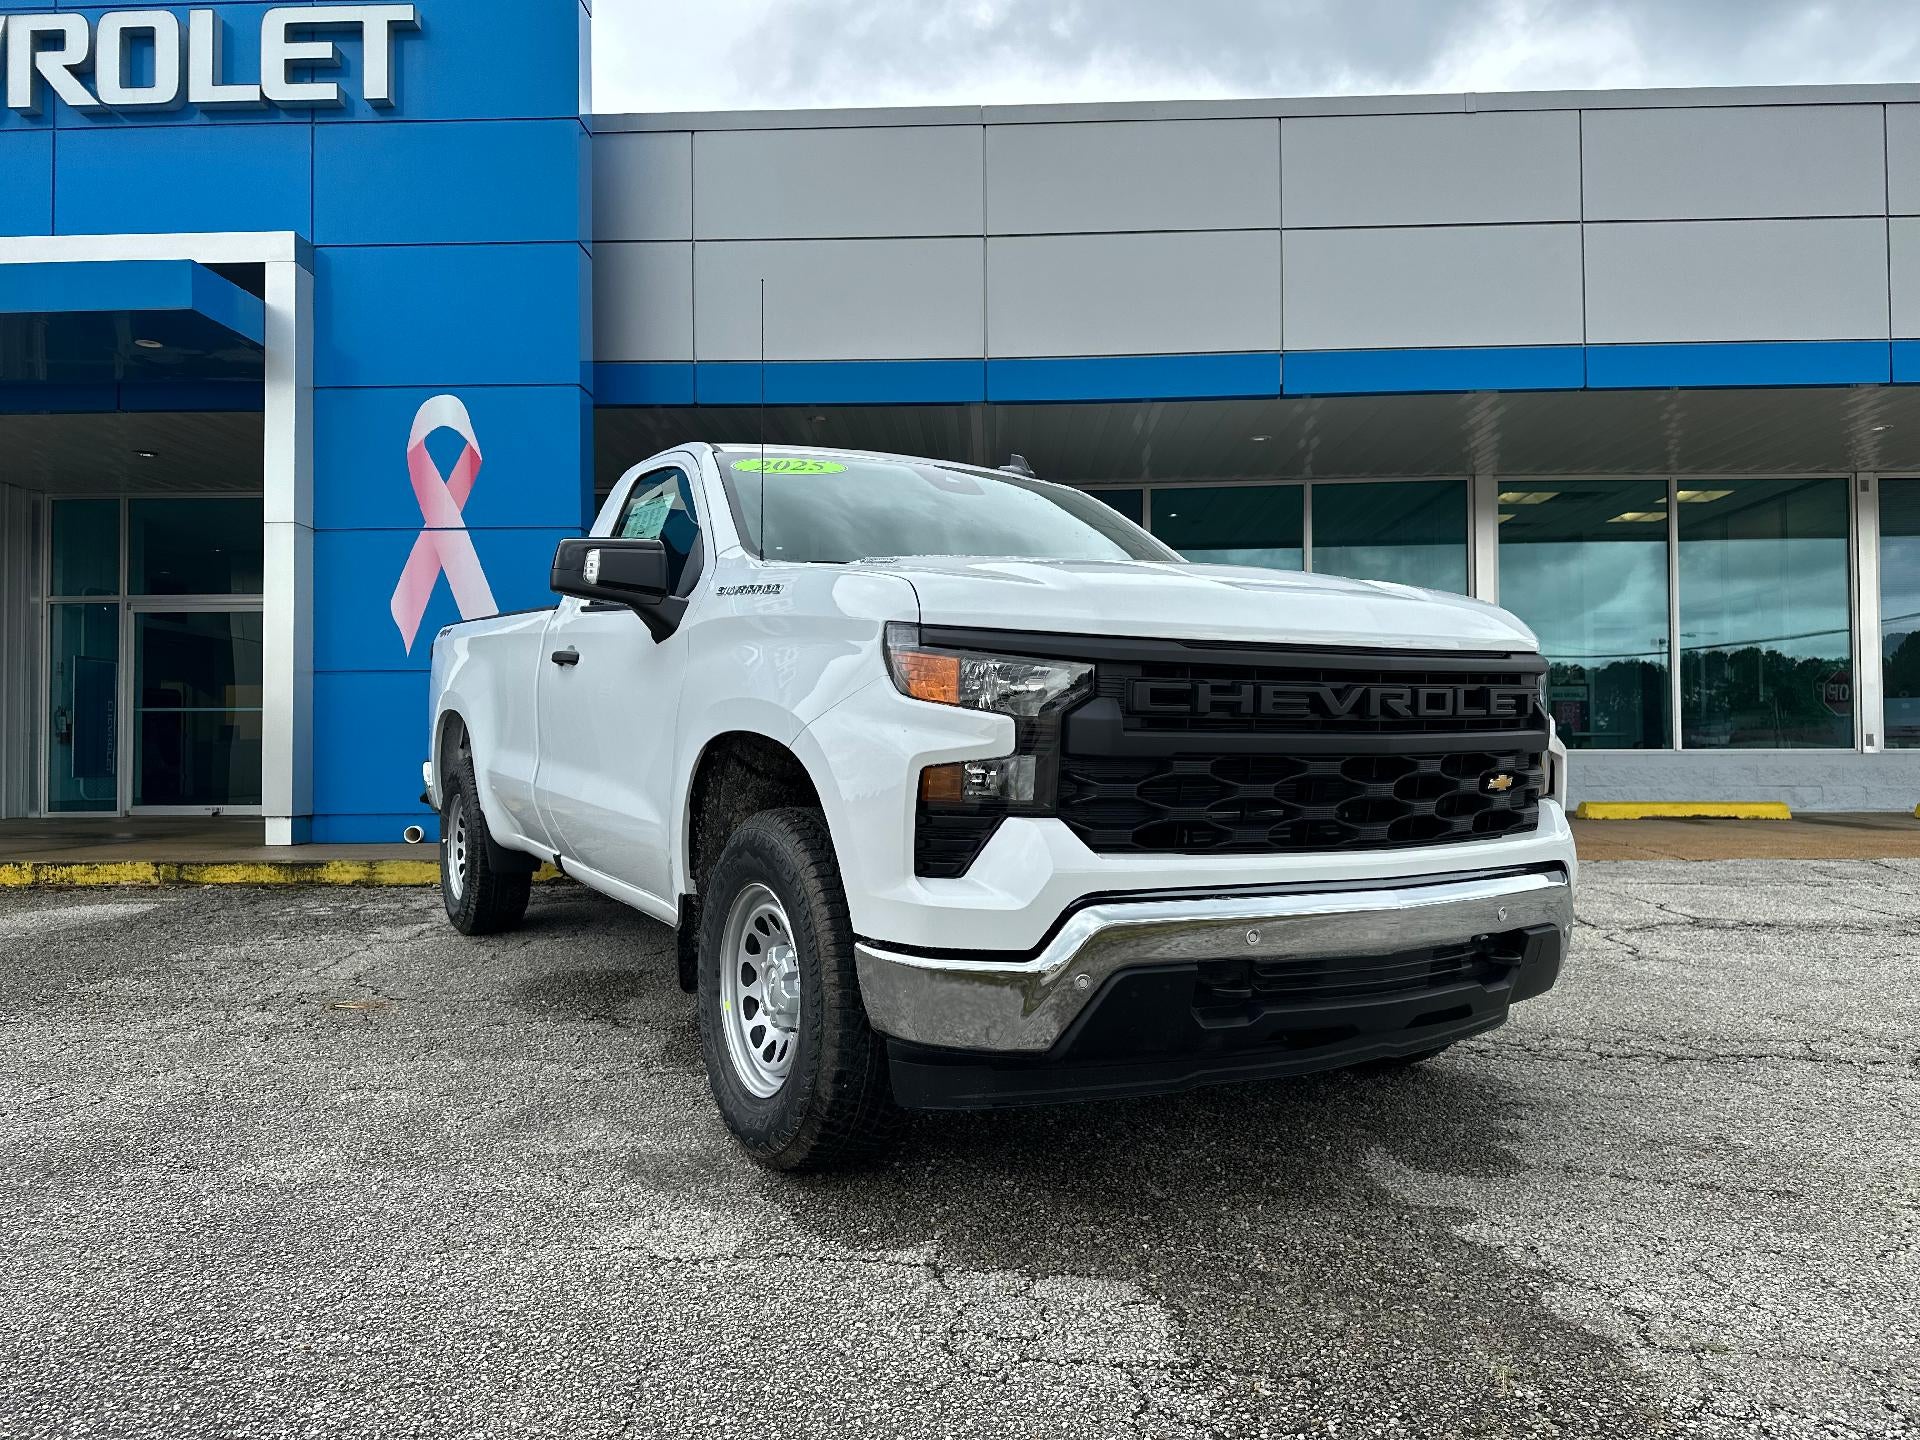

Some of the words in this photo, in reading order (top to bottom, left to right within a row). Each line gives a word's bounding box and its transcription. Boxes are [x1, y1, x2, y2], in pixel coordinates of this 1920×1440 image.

[0, 4, 418, 114] ROLET
[755, 459, 825, 471] 2025
[1133, 679, 1538, 717] CHEVROLET
